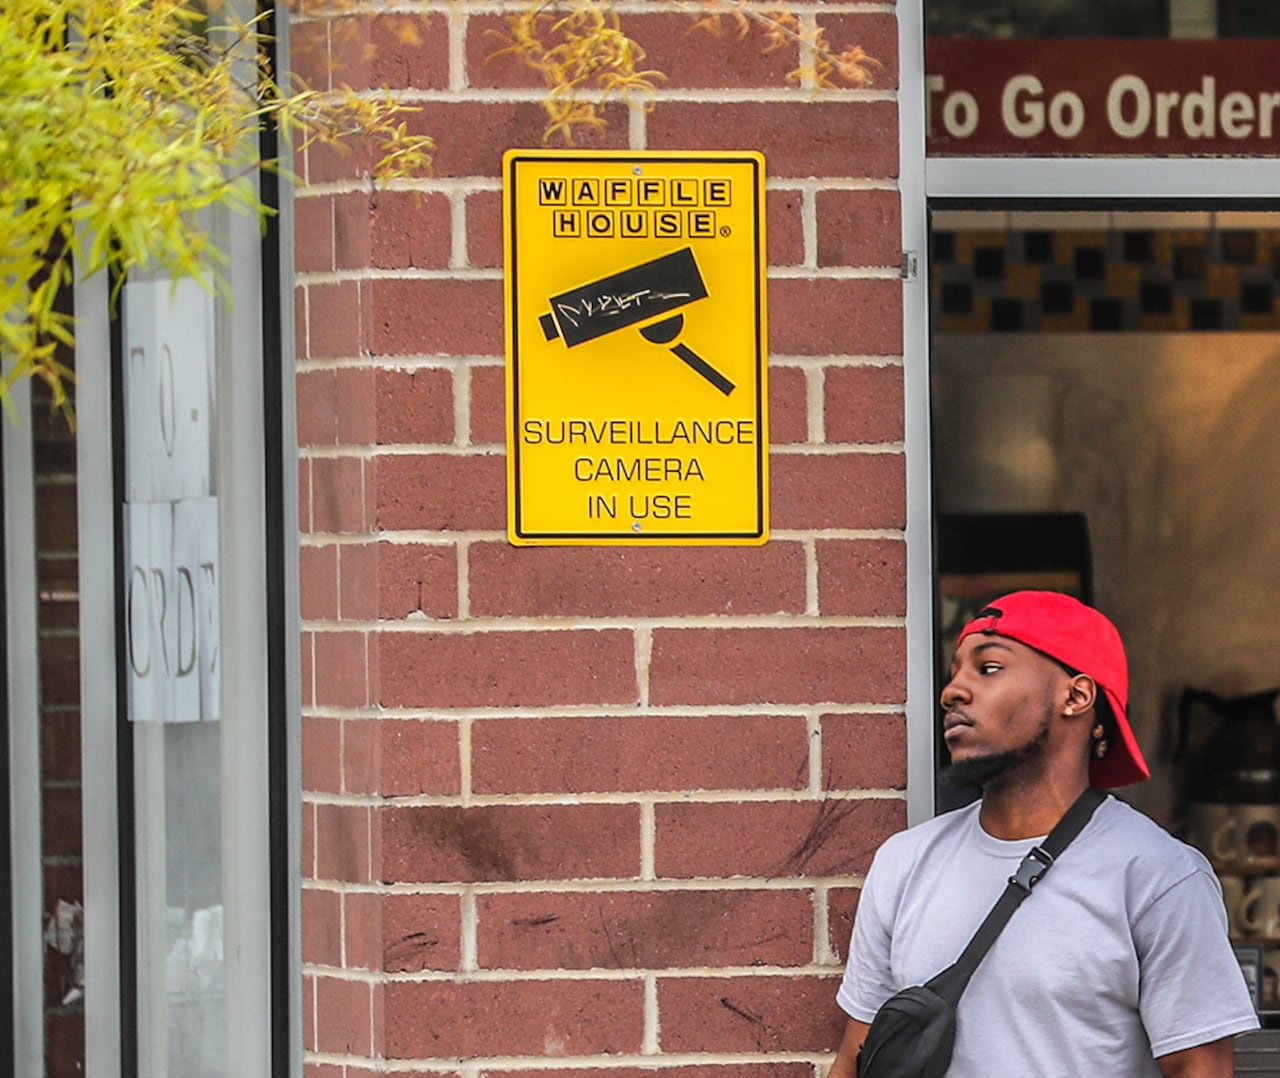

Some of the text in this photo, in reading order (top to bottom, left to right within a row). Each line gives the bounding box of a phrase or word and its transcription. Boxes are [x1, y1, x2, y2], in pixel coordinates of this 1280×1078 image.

[925, 74, 979, 139] To
[1001, 74, 1086, 140] Go
[540, 179, 731, 205] WAFFLE
[555, 211, 715, 237] HOUSE
[523, 420, 755, 446] SURVEILLANCE
[574, 457, 705, 482] CAMERA
[588, 495, 693, 519] IN USE
